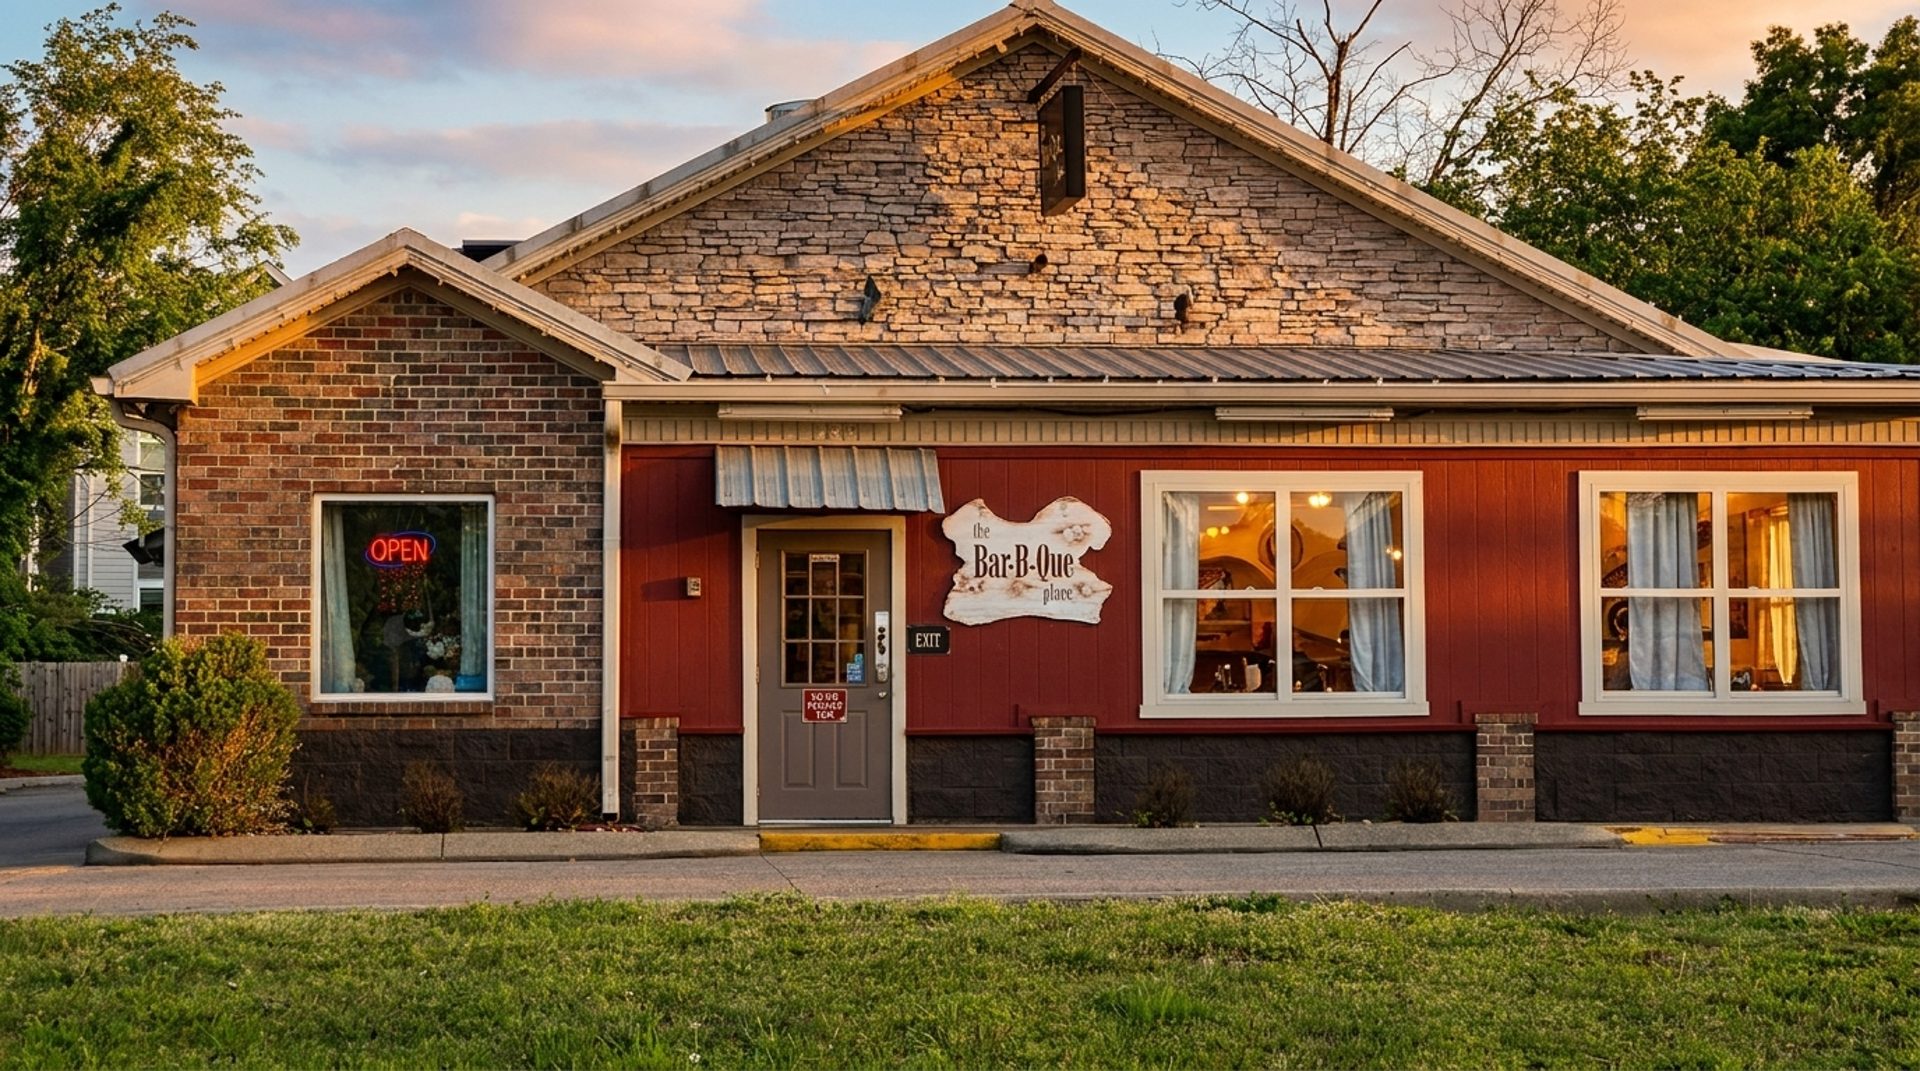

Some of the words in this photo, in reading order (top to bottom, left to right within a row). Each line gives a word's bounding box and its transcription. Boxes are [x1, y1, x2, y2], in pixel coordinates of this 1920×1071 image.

[973, 522, 990, 539] the
[371, 538, 428, 561] OPEN
[1043, 583, 1073, 605] place
[916, 632, 941, 648] EXIT
